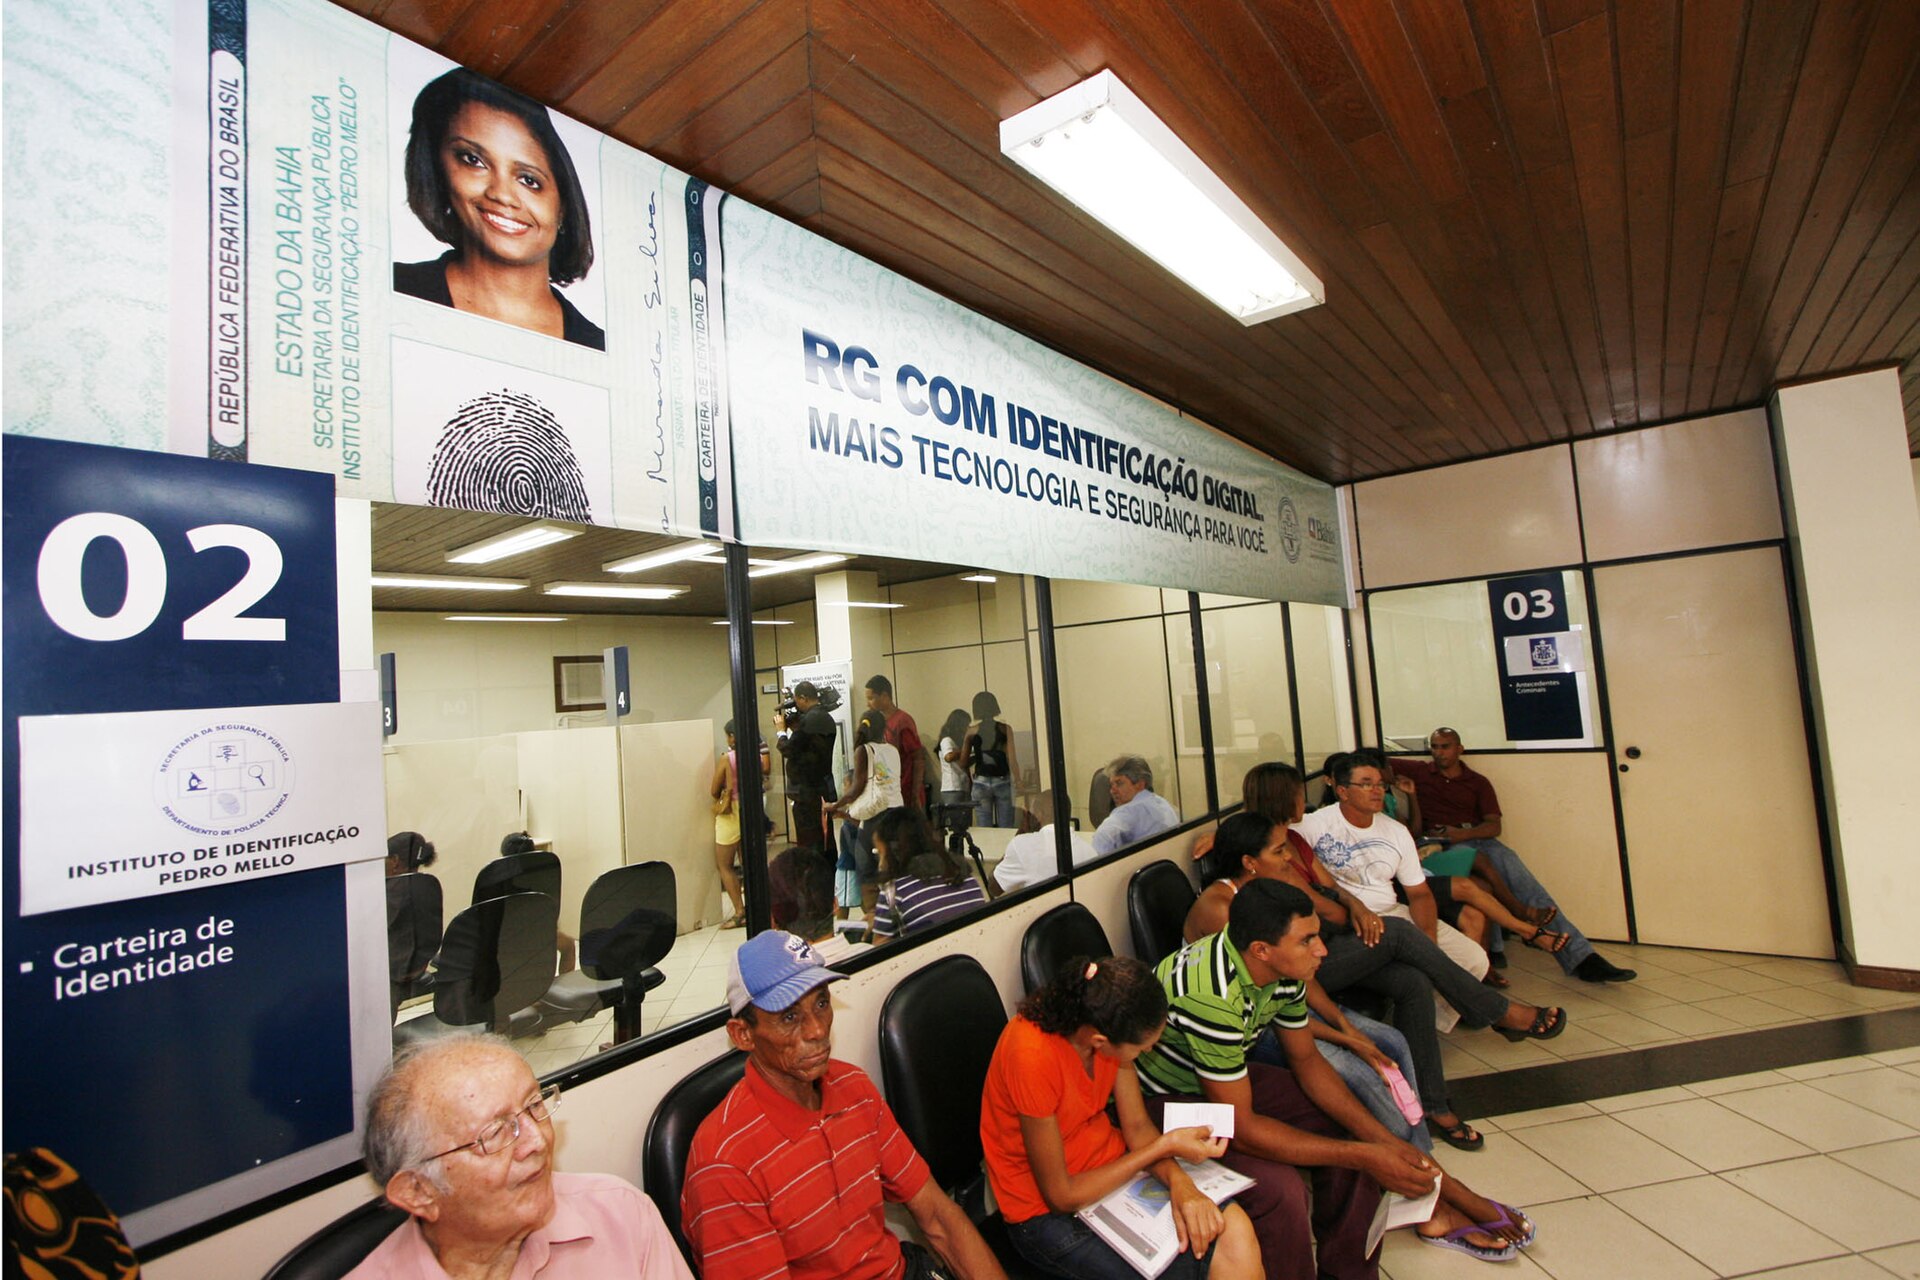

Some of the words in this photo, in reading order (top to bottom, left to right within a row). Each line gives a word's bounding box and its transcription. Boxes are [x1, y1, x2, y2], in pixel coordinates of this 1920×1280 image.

[218, 78, 240, 146] BRASIL
[308, 94, 332, 174] PÚBLICA
[338, 77, 358, 144] MELLO"
[218, 149, 240, 181] DO
[275, 146, 303, 223] BAHIA
[339, 145, 359, 213] "PEDRO
[218, 186, 240, 306] FEDERATIVA
[275, 229, 303, 265] DA
[311, 176, 336, 295] SEGURANÇA
[312, 299, 333, 325] DA
[338, 216, 363, 352] IDENTIFICAÇÃO
[275, 268, 304, 377] ESTADO
[693, 292, 709, 374] IDENTIDADE
[214, 312, 240, 425] REPÚBLICA
[312, 329, 334, 449] SECRETARIA
[341, 355, 361, 382] DE
[698, 378, 710, 396] DE
[341, 385, 362, 481] INSTITUTO
[700, 400, 713, 468] CARTEIRA
[802, 327, 882, 404] RG
[896, 364, 998, 439] COM
[1006, 401, 1199, 502] IDENTIFICAÇÃO
[1202, 475, 1265, 522] DIGITAL.
[808, 405, 904, 469] MAIS
[911, 434, 1083, 511] TECNOLOGIA
[1087, 483, 1101, 515] E
[1105, 488, 1202, 543] SEGURANÇA
[1204, 517, 1236, 547] PARA
[1236, 525, 1268, 554] VOCÊ.
[37, 511, 287, 642] 02
[1502, 588, 1555, 621] 03
[384, 707, 392, 727] 3
[617, 691, 626, 709] 4
[160, 732, 199, 773] SECRETARIA
[200, 727, 214, 736] DA
[215, 724, 267, 738] SEGURANÇA
[267, 735, 290, 763] PÚBLICA
[68, 851, 186, 880] INSTITUTO
[193, 846, 219, 862] DE
[225, 825, 360, 857] IDENTIFICAÇÃO
[162, 805, 219, 836] DEPARTAMENTO
[159, 864, 228, 886] PEDRO
[234, 853, 295, 874] MELLO
[53, 928, 187, 969] Carteira
[195, 915, 235, 941] de
[55, 943, 234, 1001] Identidade
